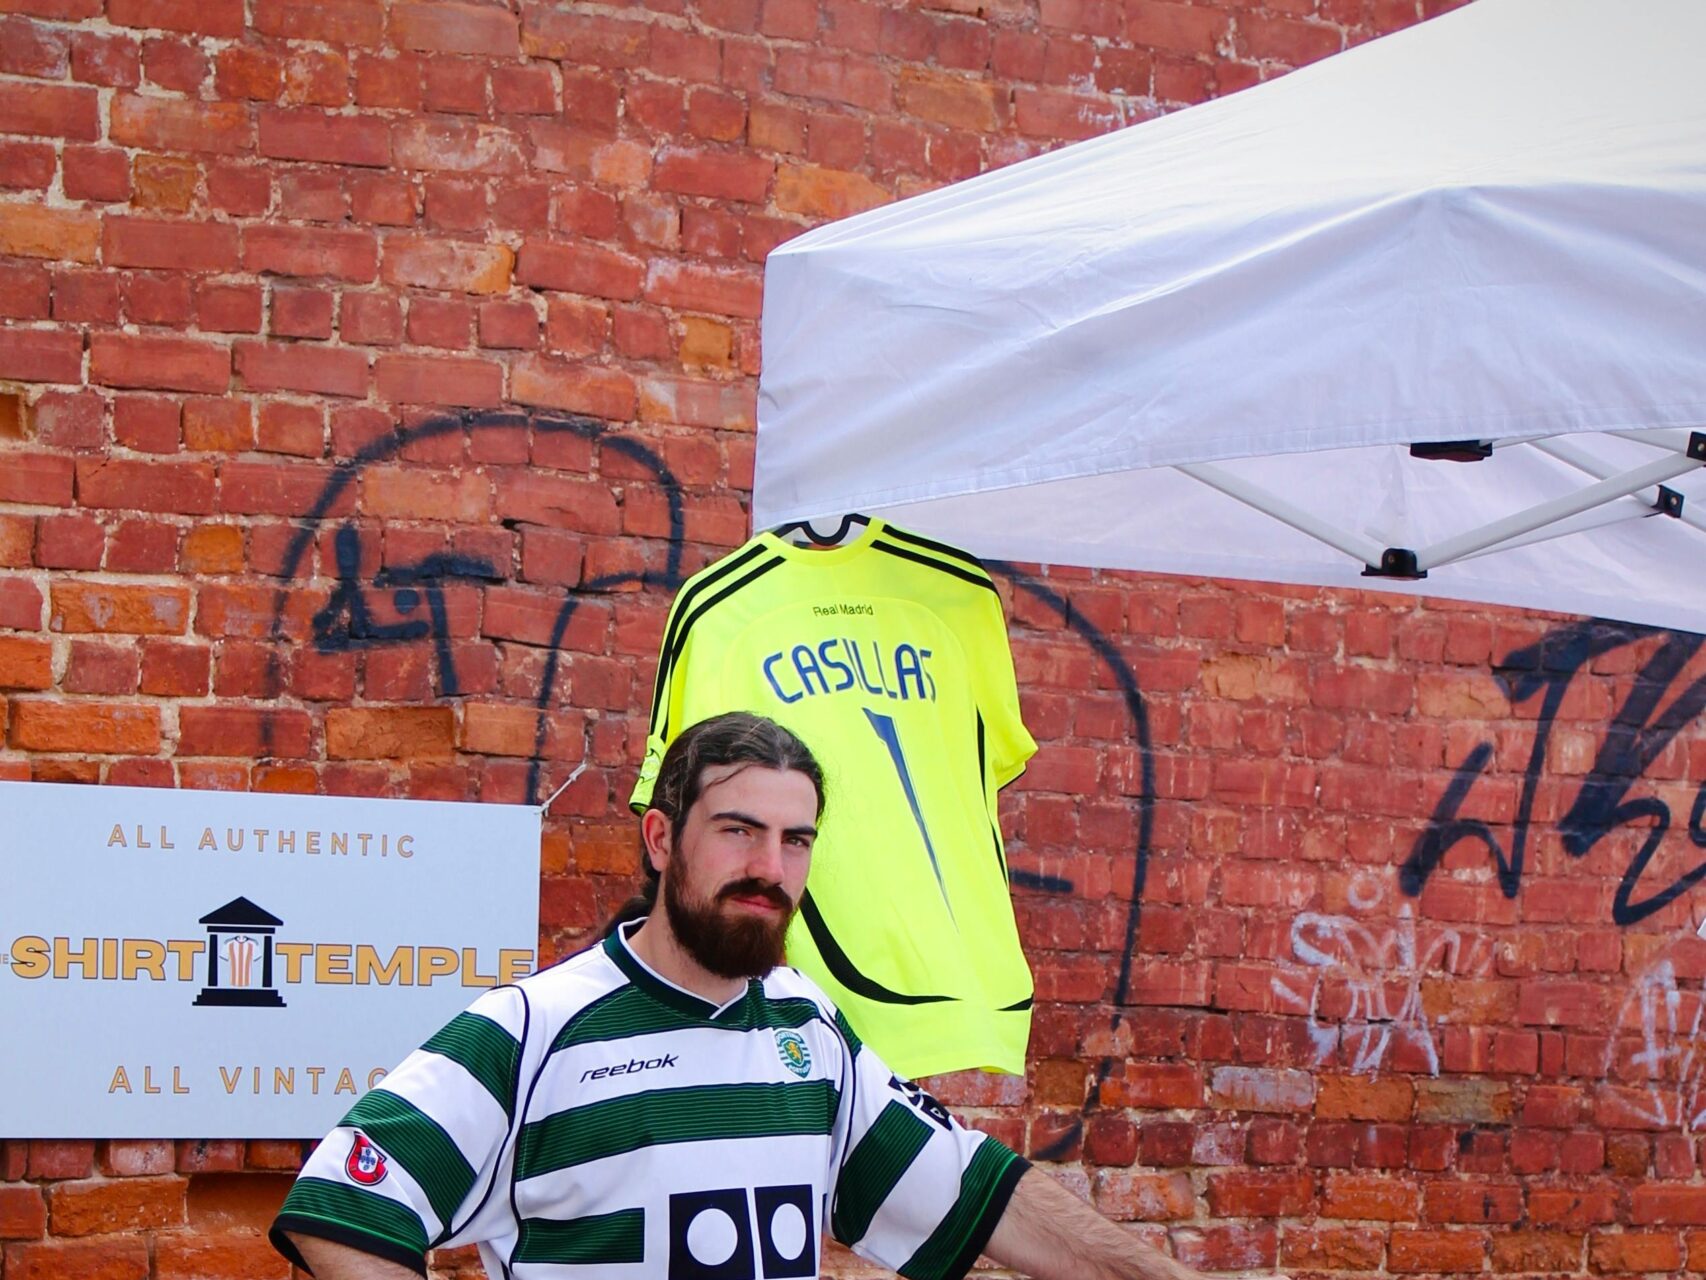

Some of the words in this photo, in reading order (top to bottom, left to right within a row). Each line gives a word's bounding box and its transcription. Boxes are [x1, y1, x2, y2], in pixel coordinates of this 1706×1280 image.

[813, 604, 838, 617] Real
[841, 604, 874, 616] Madrid
[108, 824, 175, 849] ALL
[198, 827, 416, 858] AUTHENTIC
[10, 935, 206, 981] SHIRT
[275, 943, 535, 988] TEMPLE
[108, 1066, 190, 1095] ALL
[579, 1053, 679, 1084] reebok
